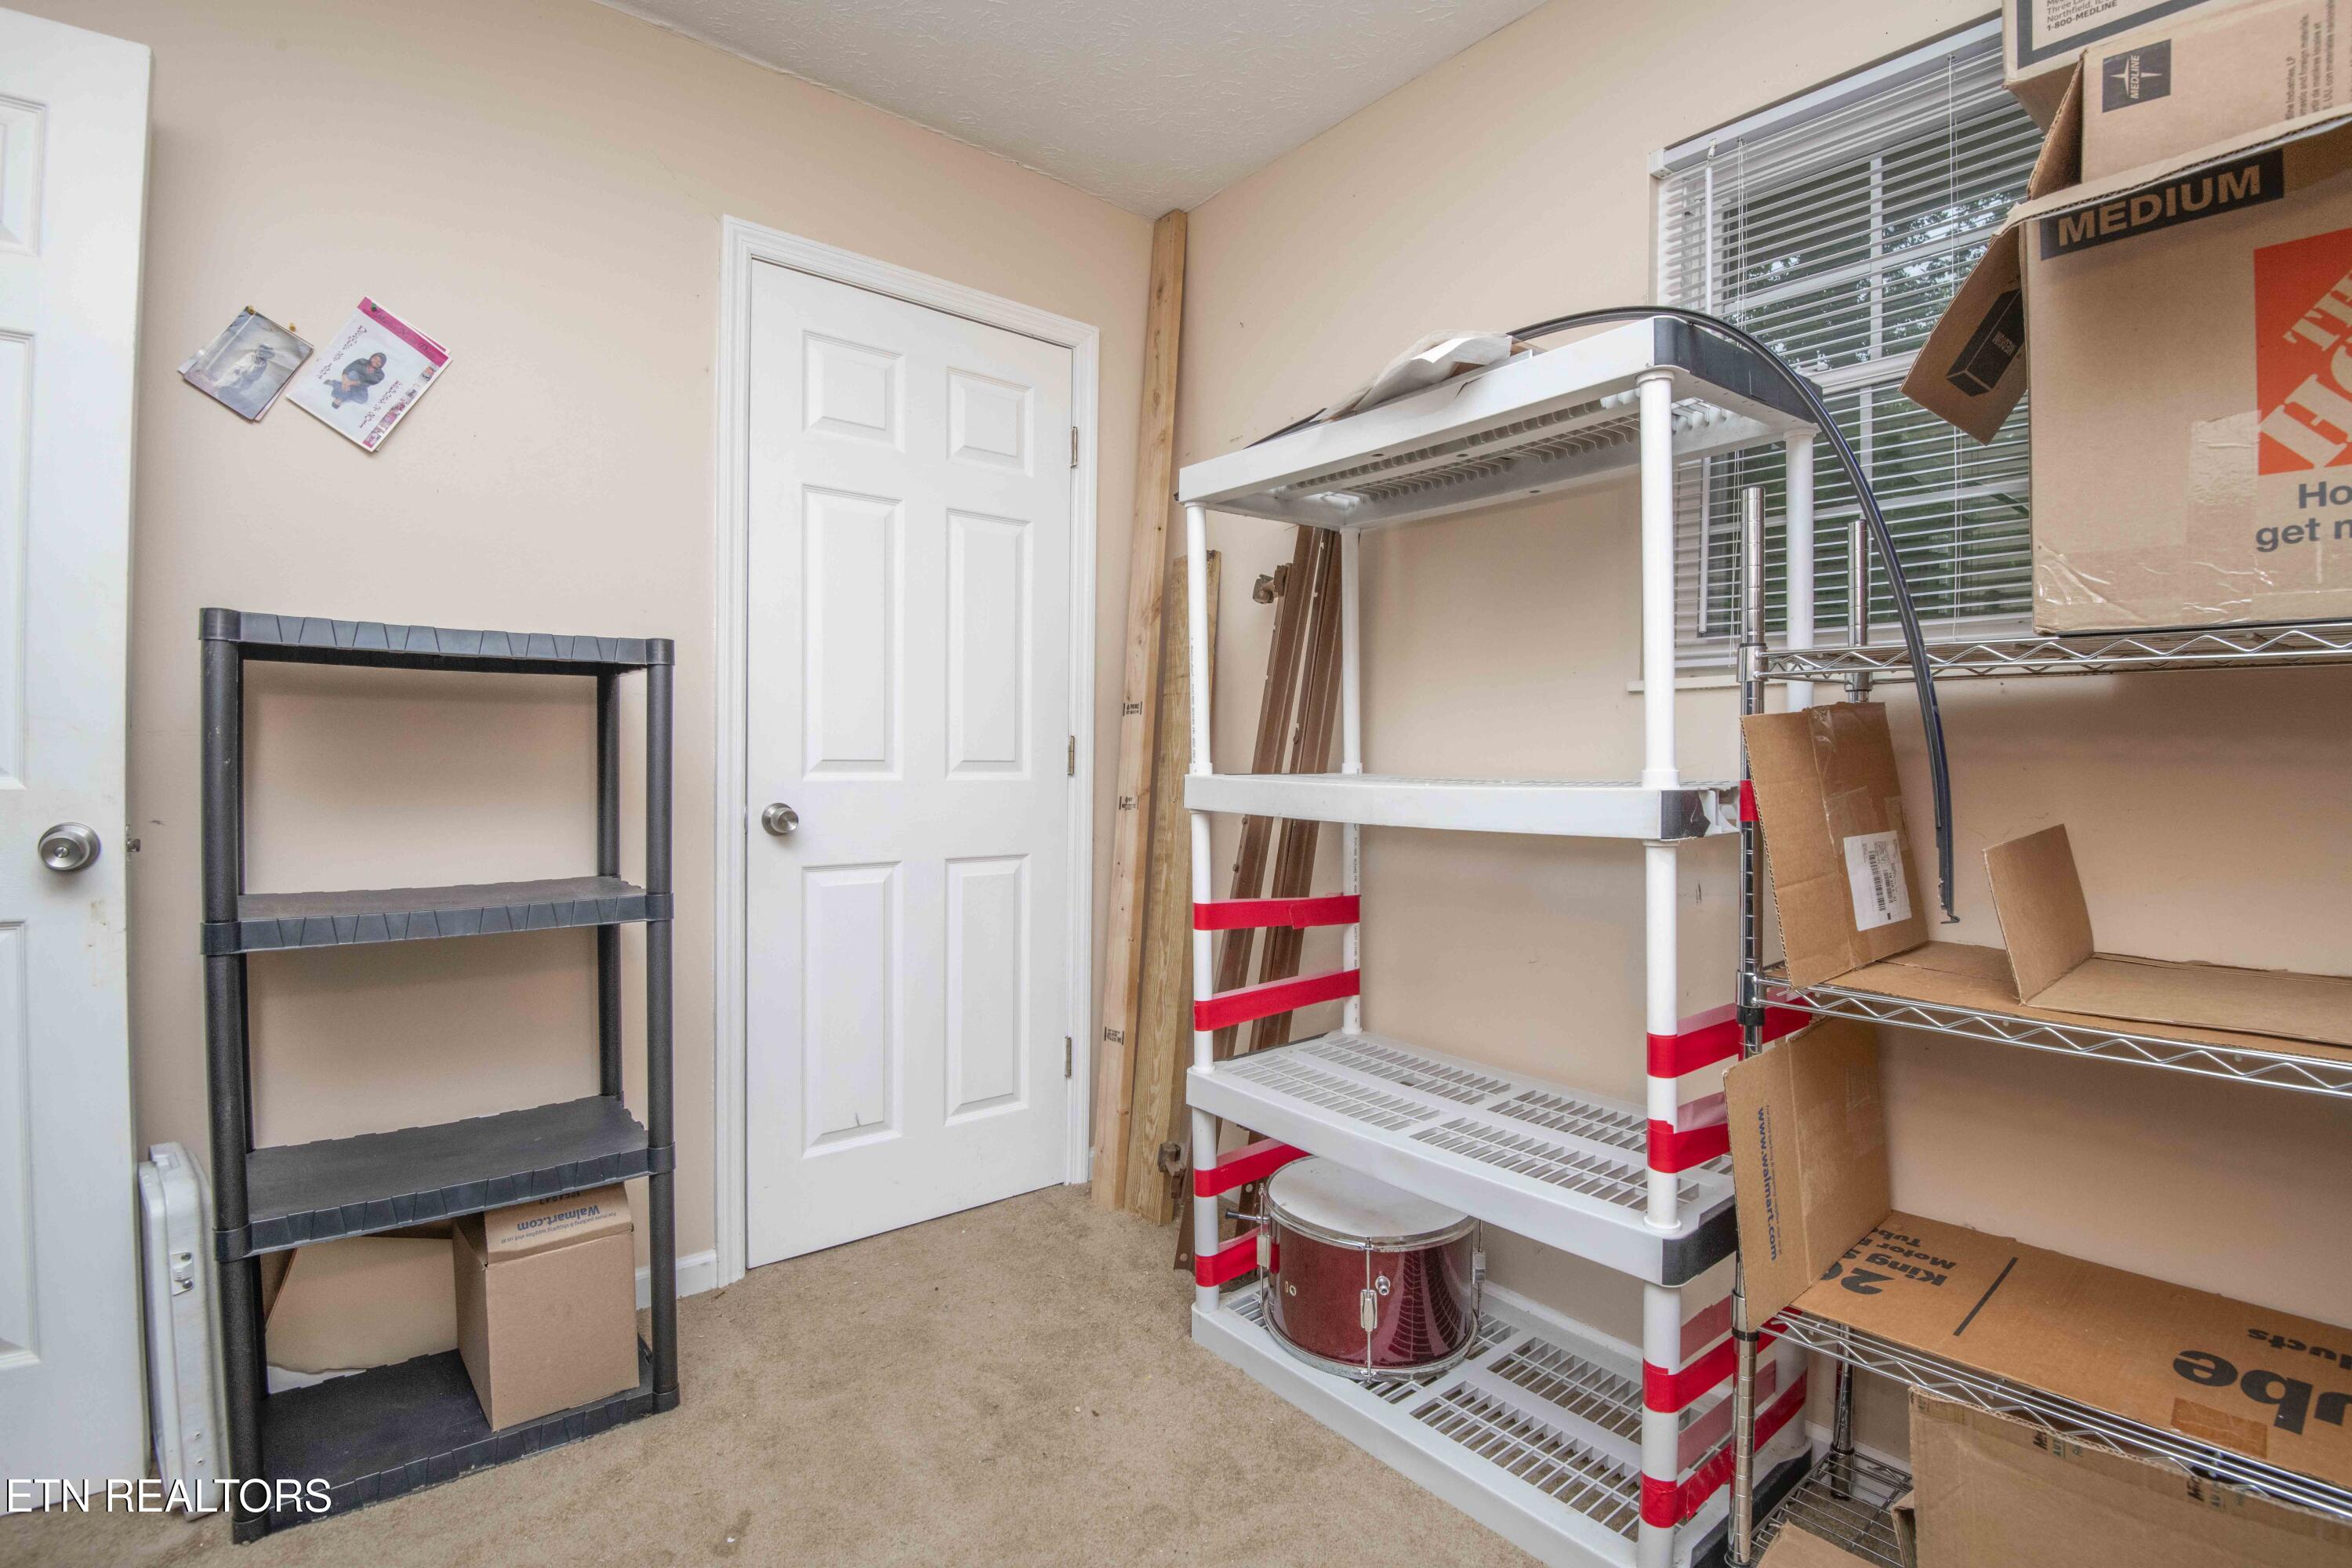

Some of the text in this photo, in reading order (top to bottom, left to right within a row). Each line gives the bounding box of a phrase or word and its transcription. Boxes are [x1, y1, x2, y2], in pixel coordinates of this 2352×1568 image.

[2046, 0, 2118, 31] 1-800-MEDLINE
[2130, 55, 2140, 99] MEDLINE
[2058, 164, 2261, 247] MEDIUM
[2256, 517, 2321, 553] get
[1758, 1106, 1777, 1261] www.walmart.com
[517, 1205, 601, 1231] Walmart.com
[1865, 1253, 1948, 1287] King
[1877, 1243, 1957, 1269] Motor
